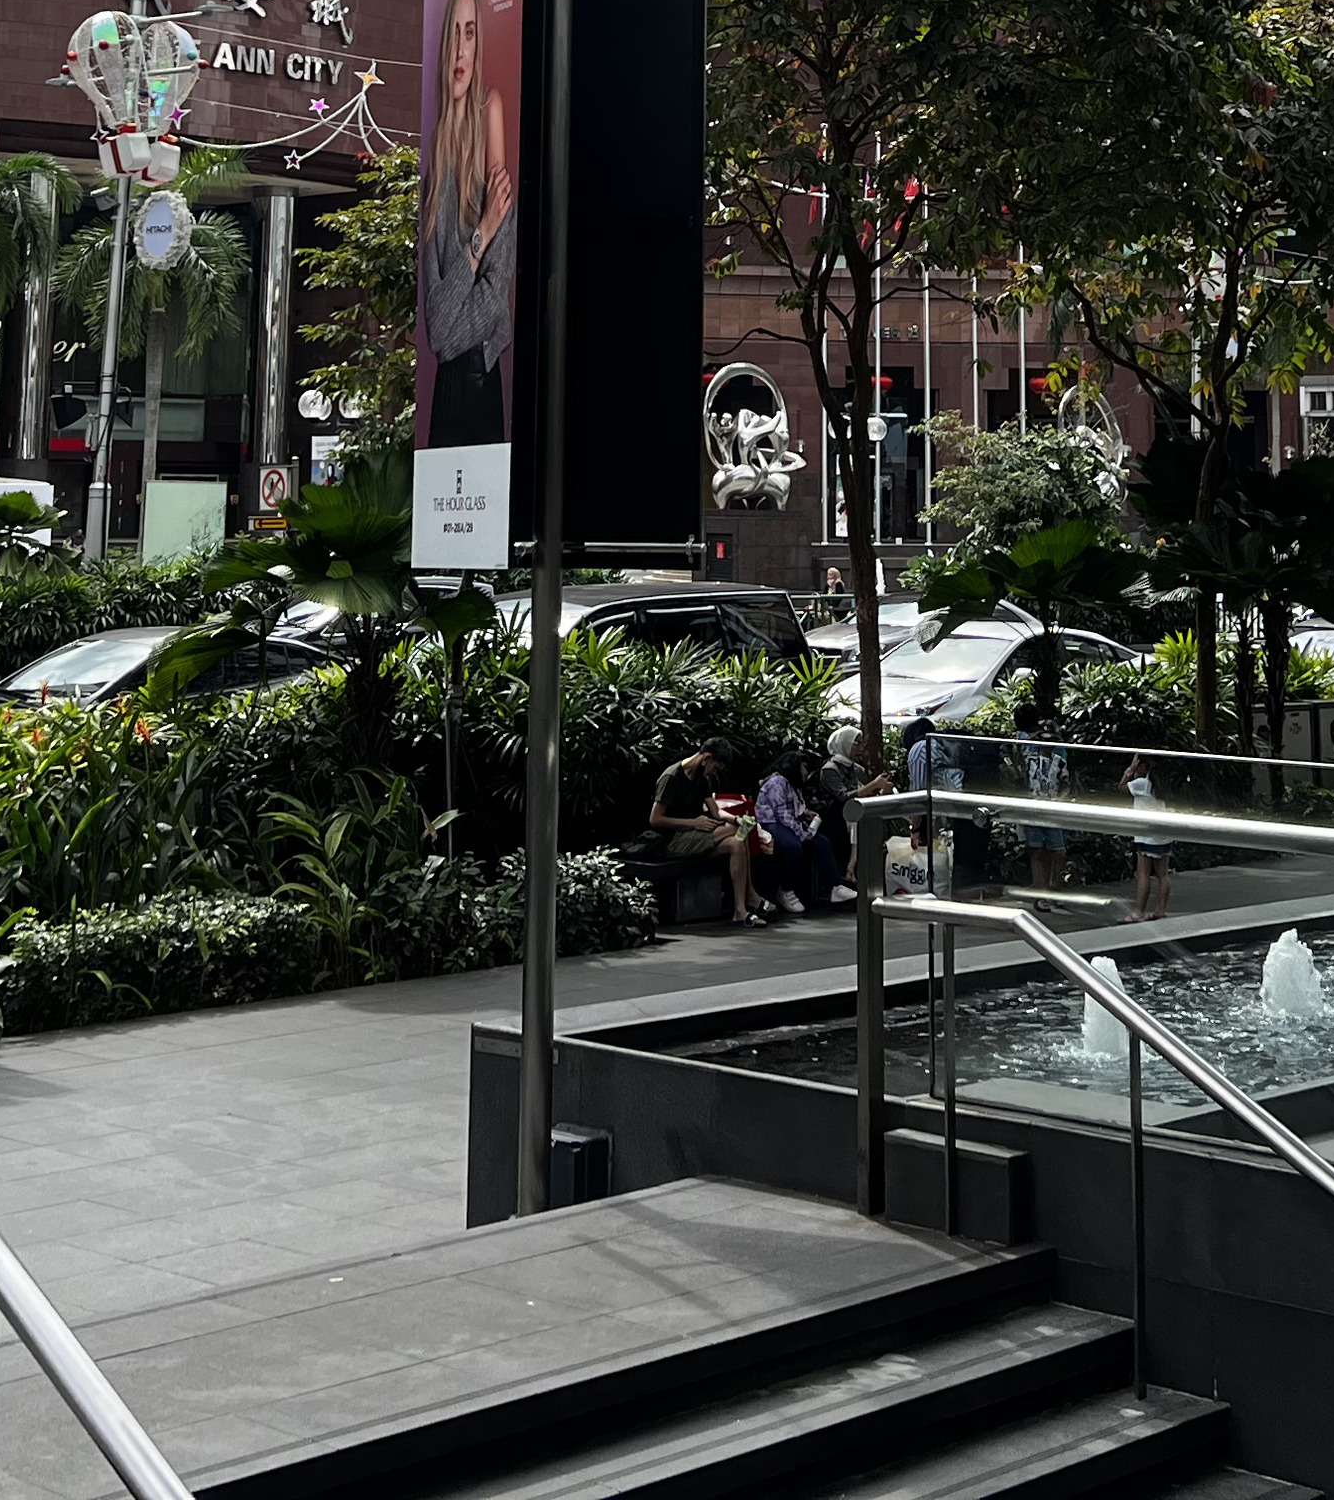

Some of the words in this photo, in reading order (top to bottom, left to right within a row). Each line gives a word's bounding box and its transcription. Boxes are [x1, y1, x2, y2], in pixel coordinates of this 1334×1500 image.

[213, 42, 275, 76] ANN
[287, 51, 344, 86] CITY
[146, 224, 173, 234] HITACHI
[434, 498, 444, 511] THE
[445, 496, 464, 511] HOUR
[464, 495, 486, 511] GLASS
